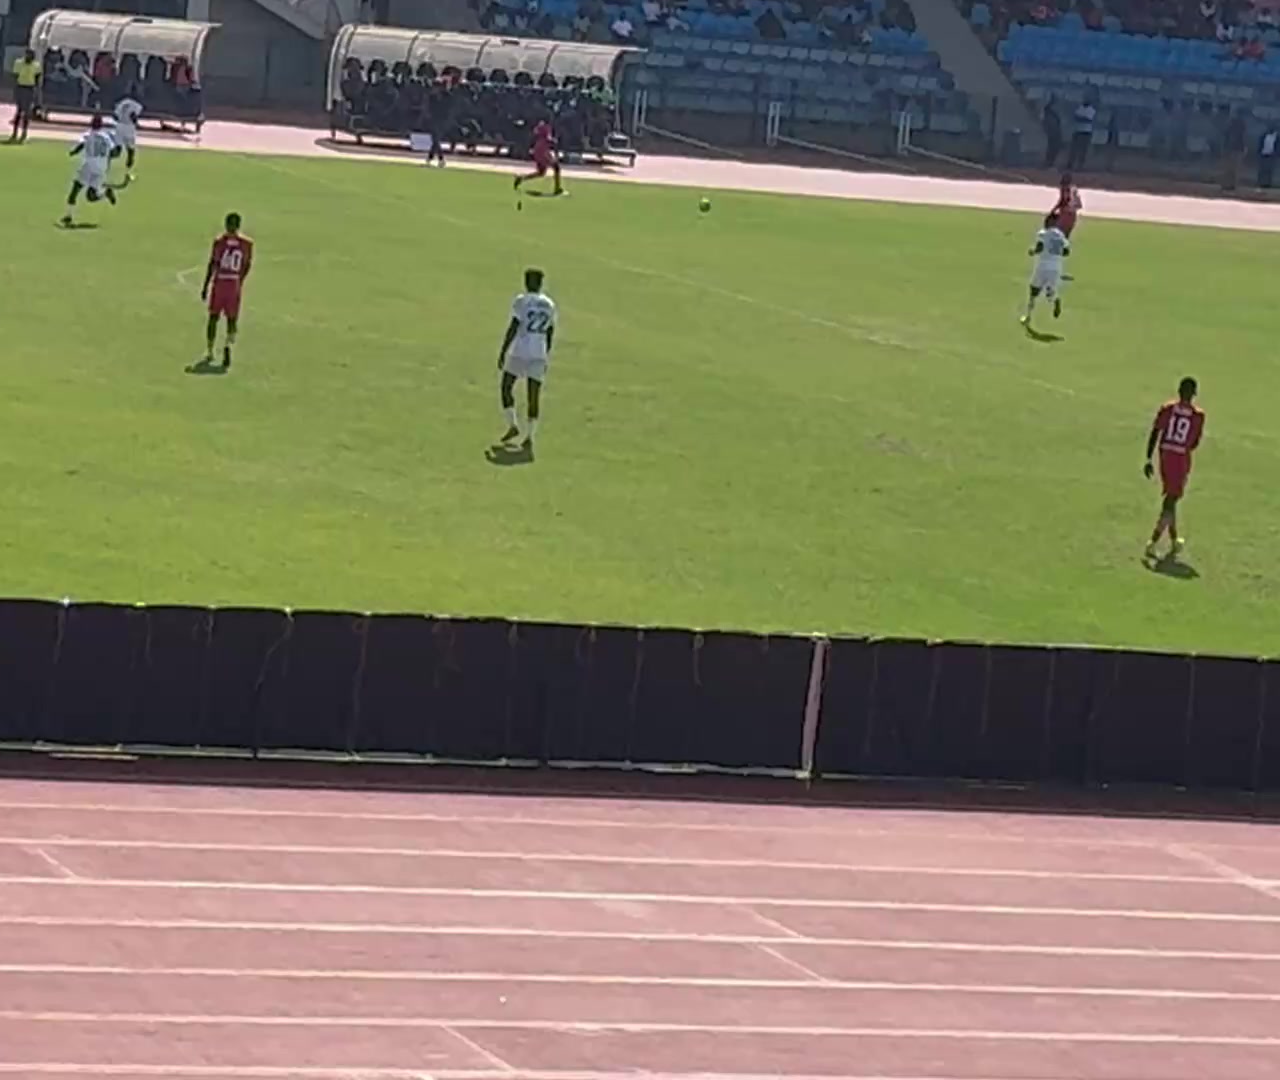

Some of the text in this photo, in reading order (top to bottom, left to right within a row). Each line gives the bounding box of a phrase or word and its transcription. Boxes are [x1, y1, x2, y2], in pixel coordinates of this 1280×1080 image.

[221, 249, 242, 270] 40
[527, 310, 549, 334] 22
[1167, 415, 1190, 442] 19
